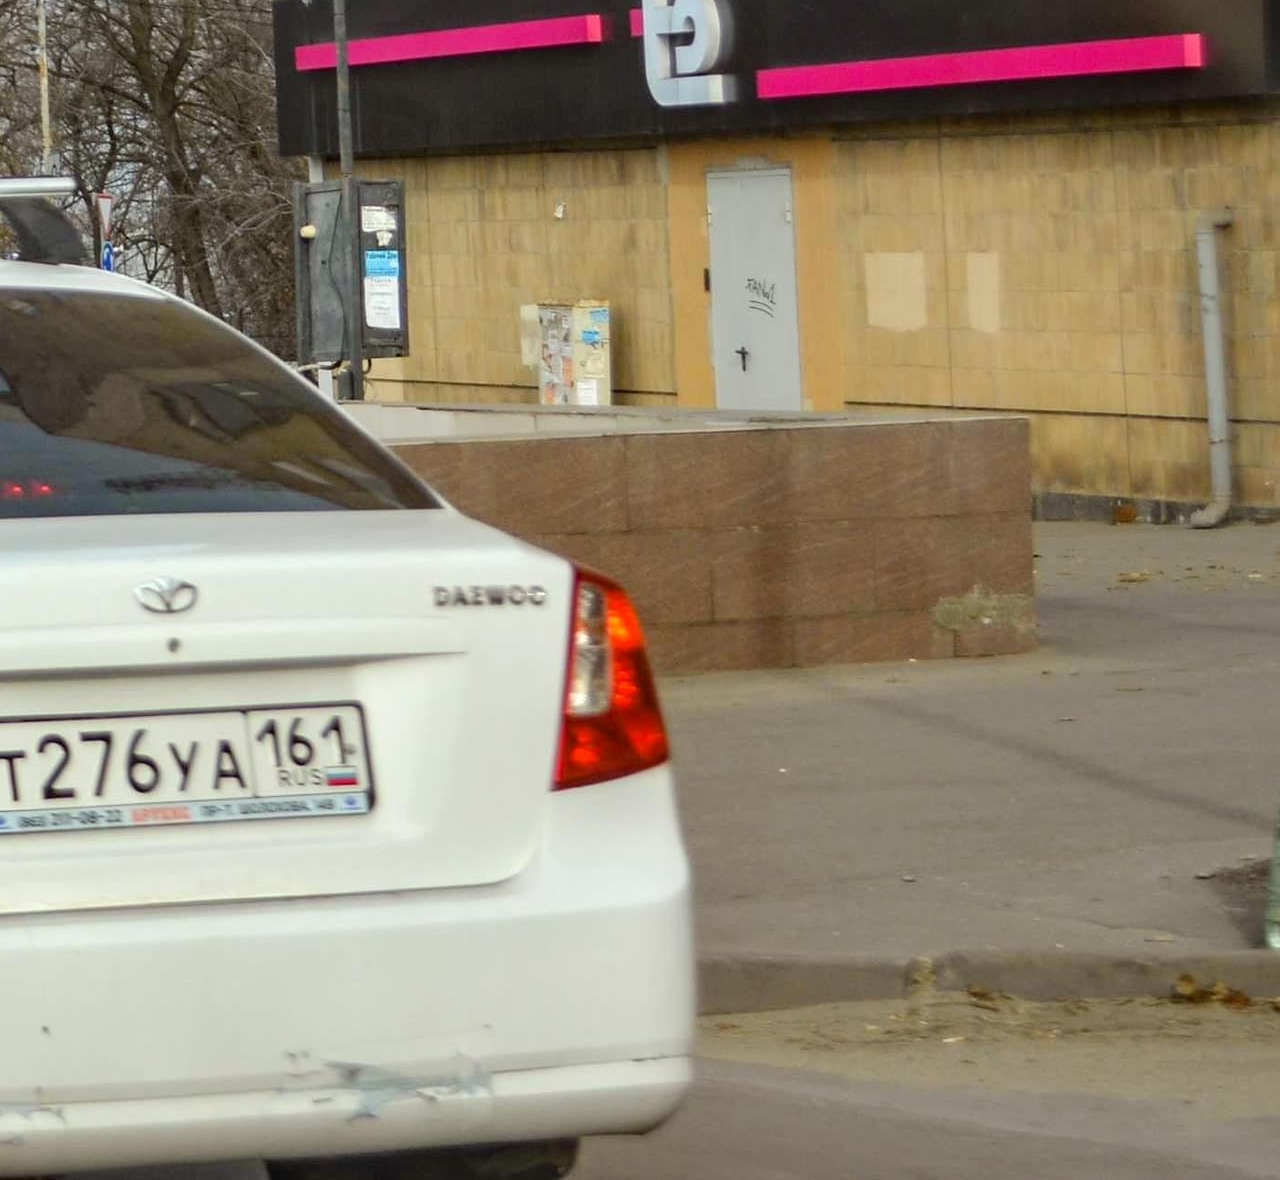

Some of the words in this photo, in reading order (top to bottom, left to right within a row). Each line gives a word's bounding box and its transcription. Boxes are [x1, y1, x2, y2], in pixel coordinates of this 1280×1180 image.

[432, 584, 546, 606] DAEWOO
[255, 716, 349, 768] 161
[278, 768, 323, 788] RUS
